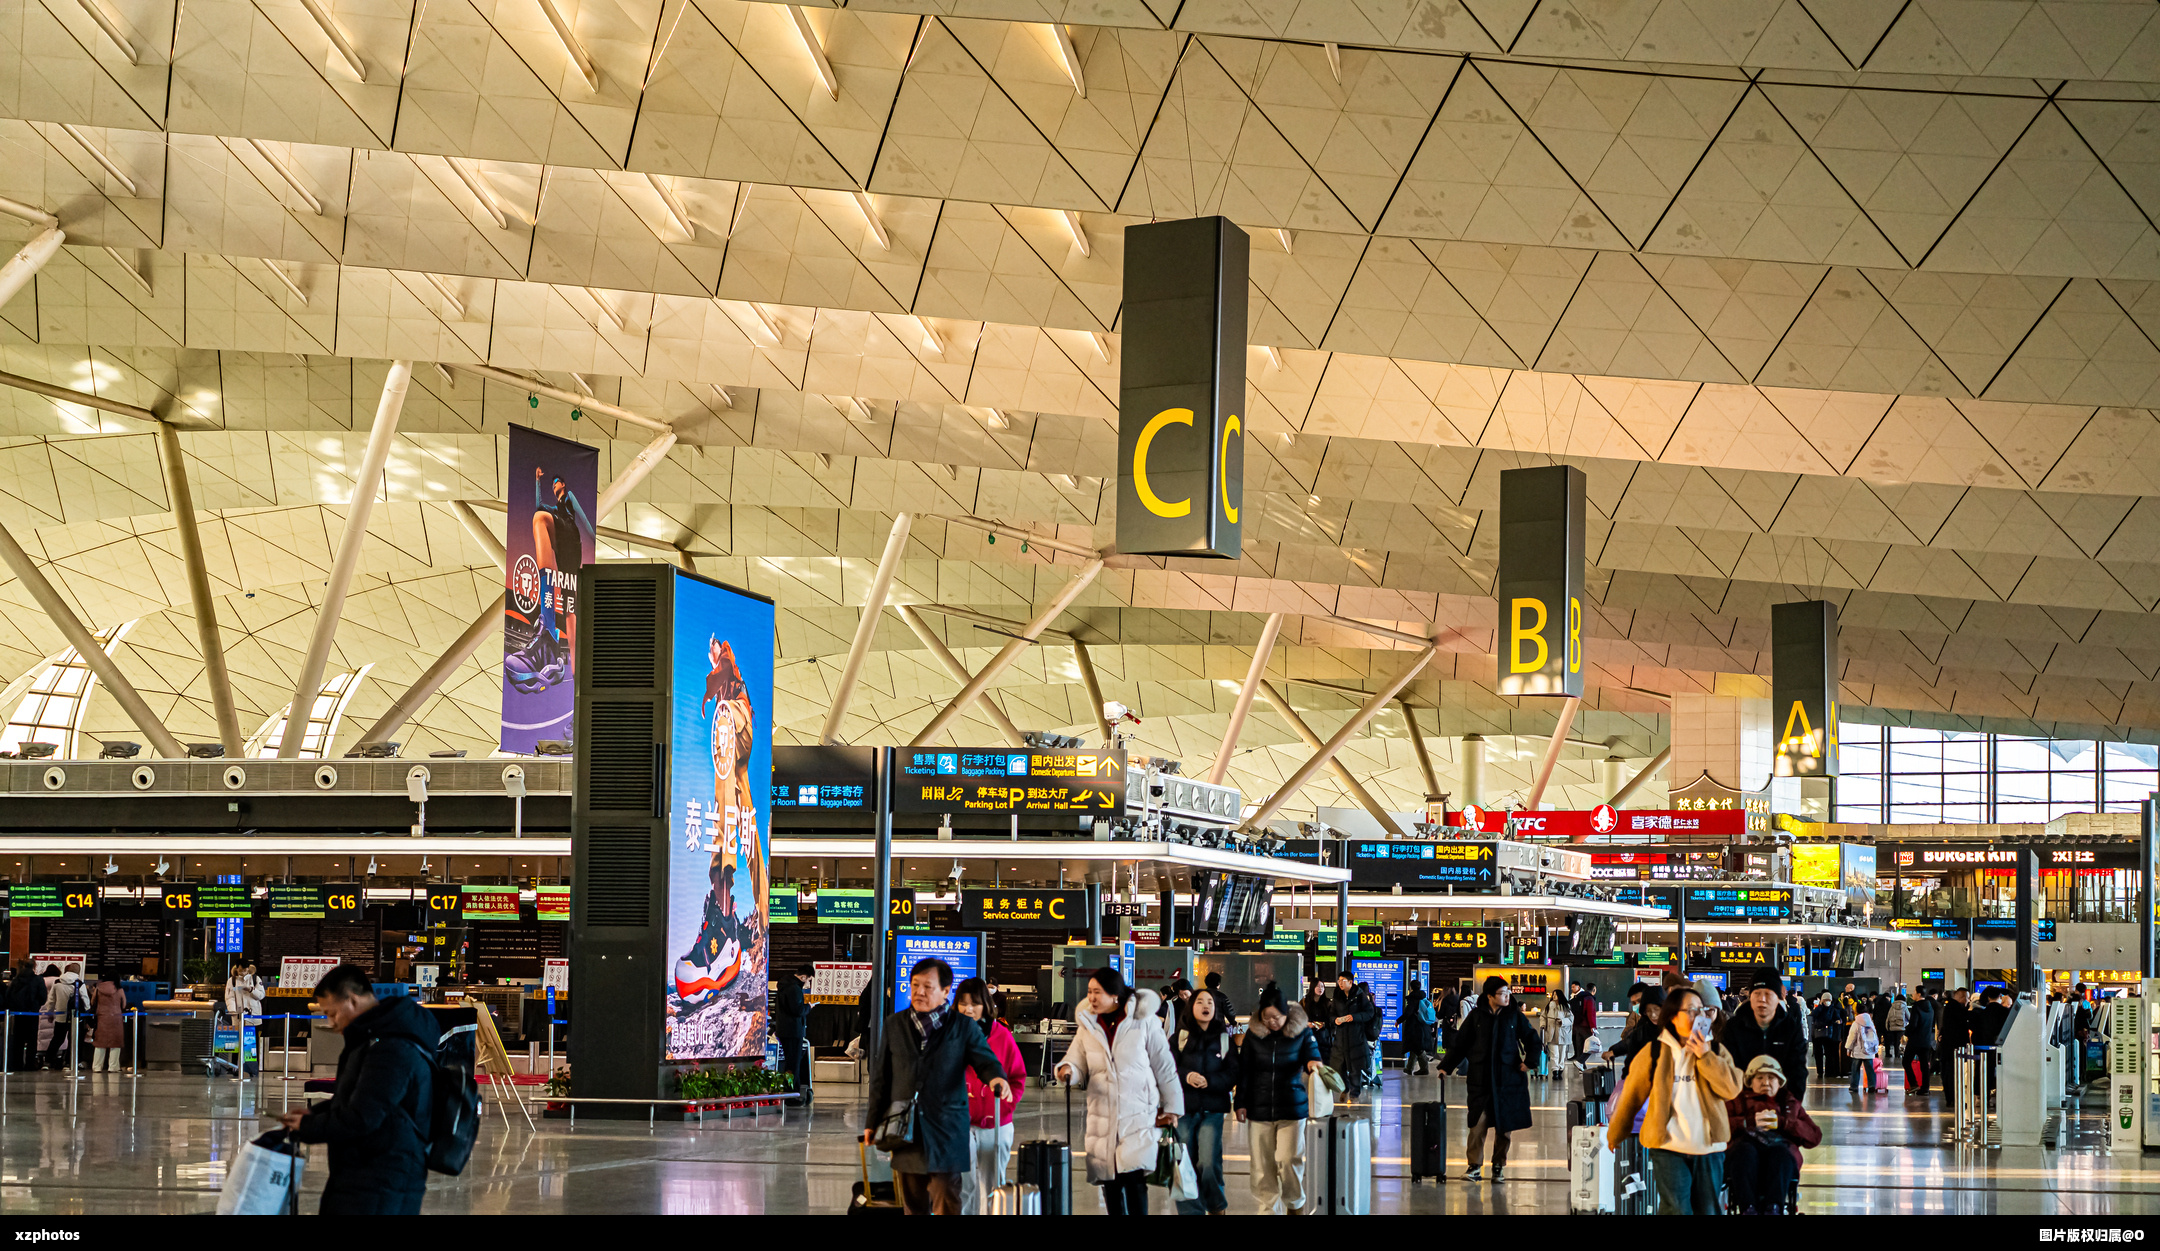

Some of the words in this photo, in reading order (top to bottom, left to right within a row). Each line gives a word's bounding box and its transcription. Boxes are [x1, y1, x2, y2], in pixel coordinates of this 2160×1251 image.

[1133, 408, 1194, 518] C
[1221, 414, 1240, 524] C
[1510, 598, 1548, 674] B
[1570, 596, 1581, 674] B
[1776, 700, 1820, 760] A
[1828, 700, 1838, 760] A
[913, 754, 935, 766] 售票
[962, 754, 1006, 766] 行李打包
[1031, 754, 1076, 768] 国内出发
[904, 766, 936, 776] Ticketing
[962, 768, 984, 776] Baggage
[985, 768, 1006, 778] Packing
[1031, 768, 1051, 776] Domestic
[1052, 768, 1076, 778] Departures
[820, 785, 864, 798] 行李寄存
[977, 786, 1008, 798] 停车场
[1009, 788, 1025, 808] P
[1027, 788, 1068, 800] 到达大厅
[820, 800, 842, 808] Baggage
[842, 800, 863, 808] Deposit
[965, 800, 994, 810] Parking
[685, 797, 756, 860] 泰兰尼斯
[1632, 816, 1672, 830] 喜家德
[1924, 851, 1984, 862] BURGER
[1440, 866, 1476, 875] 国内易登机
[66, 894, 94, 908] C14
[165, 894, 192, 908] C15
[328, 895, 356, 910] C16
[430, 895, 458, 910] C17
[983, 898, 1043, 909] 服务柜台
[1049, 898, 1066, 920] C
[983, 912, 1008, 920] Service
[1010, 912, 1041, 920] Counter
[1110, 905, 1140, 915] 13:34
[906, 939, 970, 949] 国内值机柜台分布
[1360, 934, 1382, 944] B20
[1477, 933, 1487, 947] B
[901, 955, 908, 964] A
[1755, 952, 1765, 963] A
[901, 968, 907, 977] B
[900, 983, 906, 992] C
